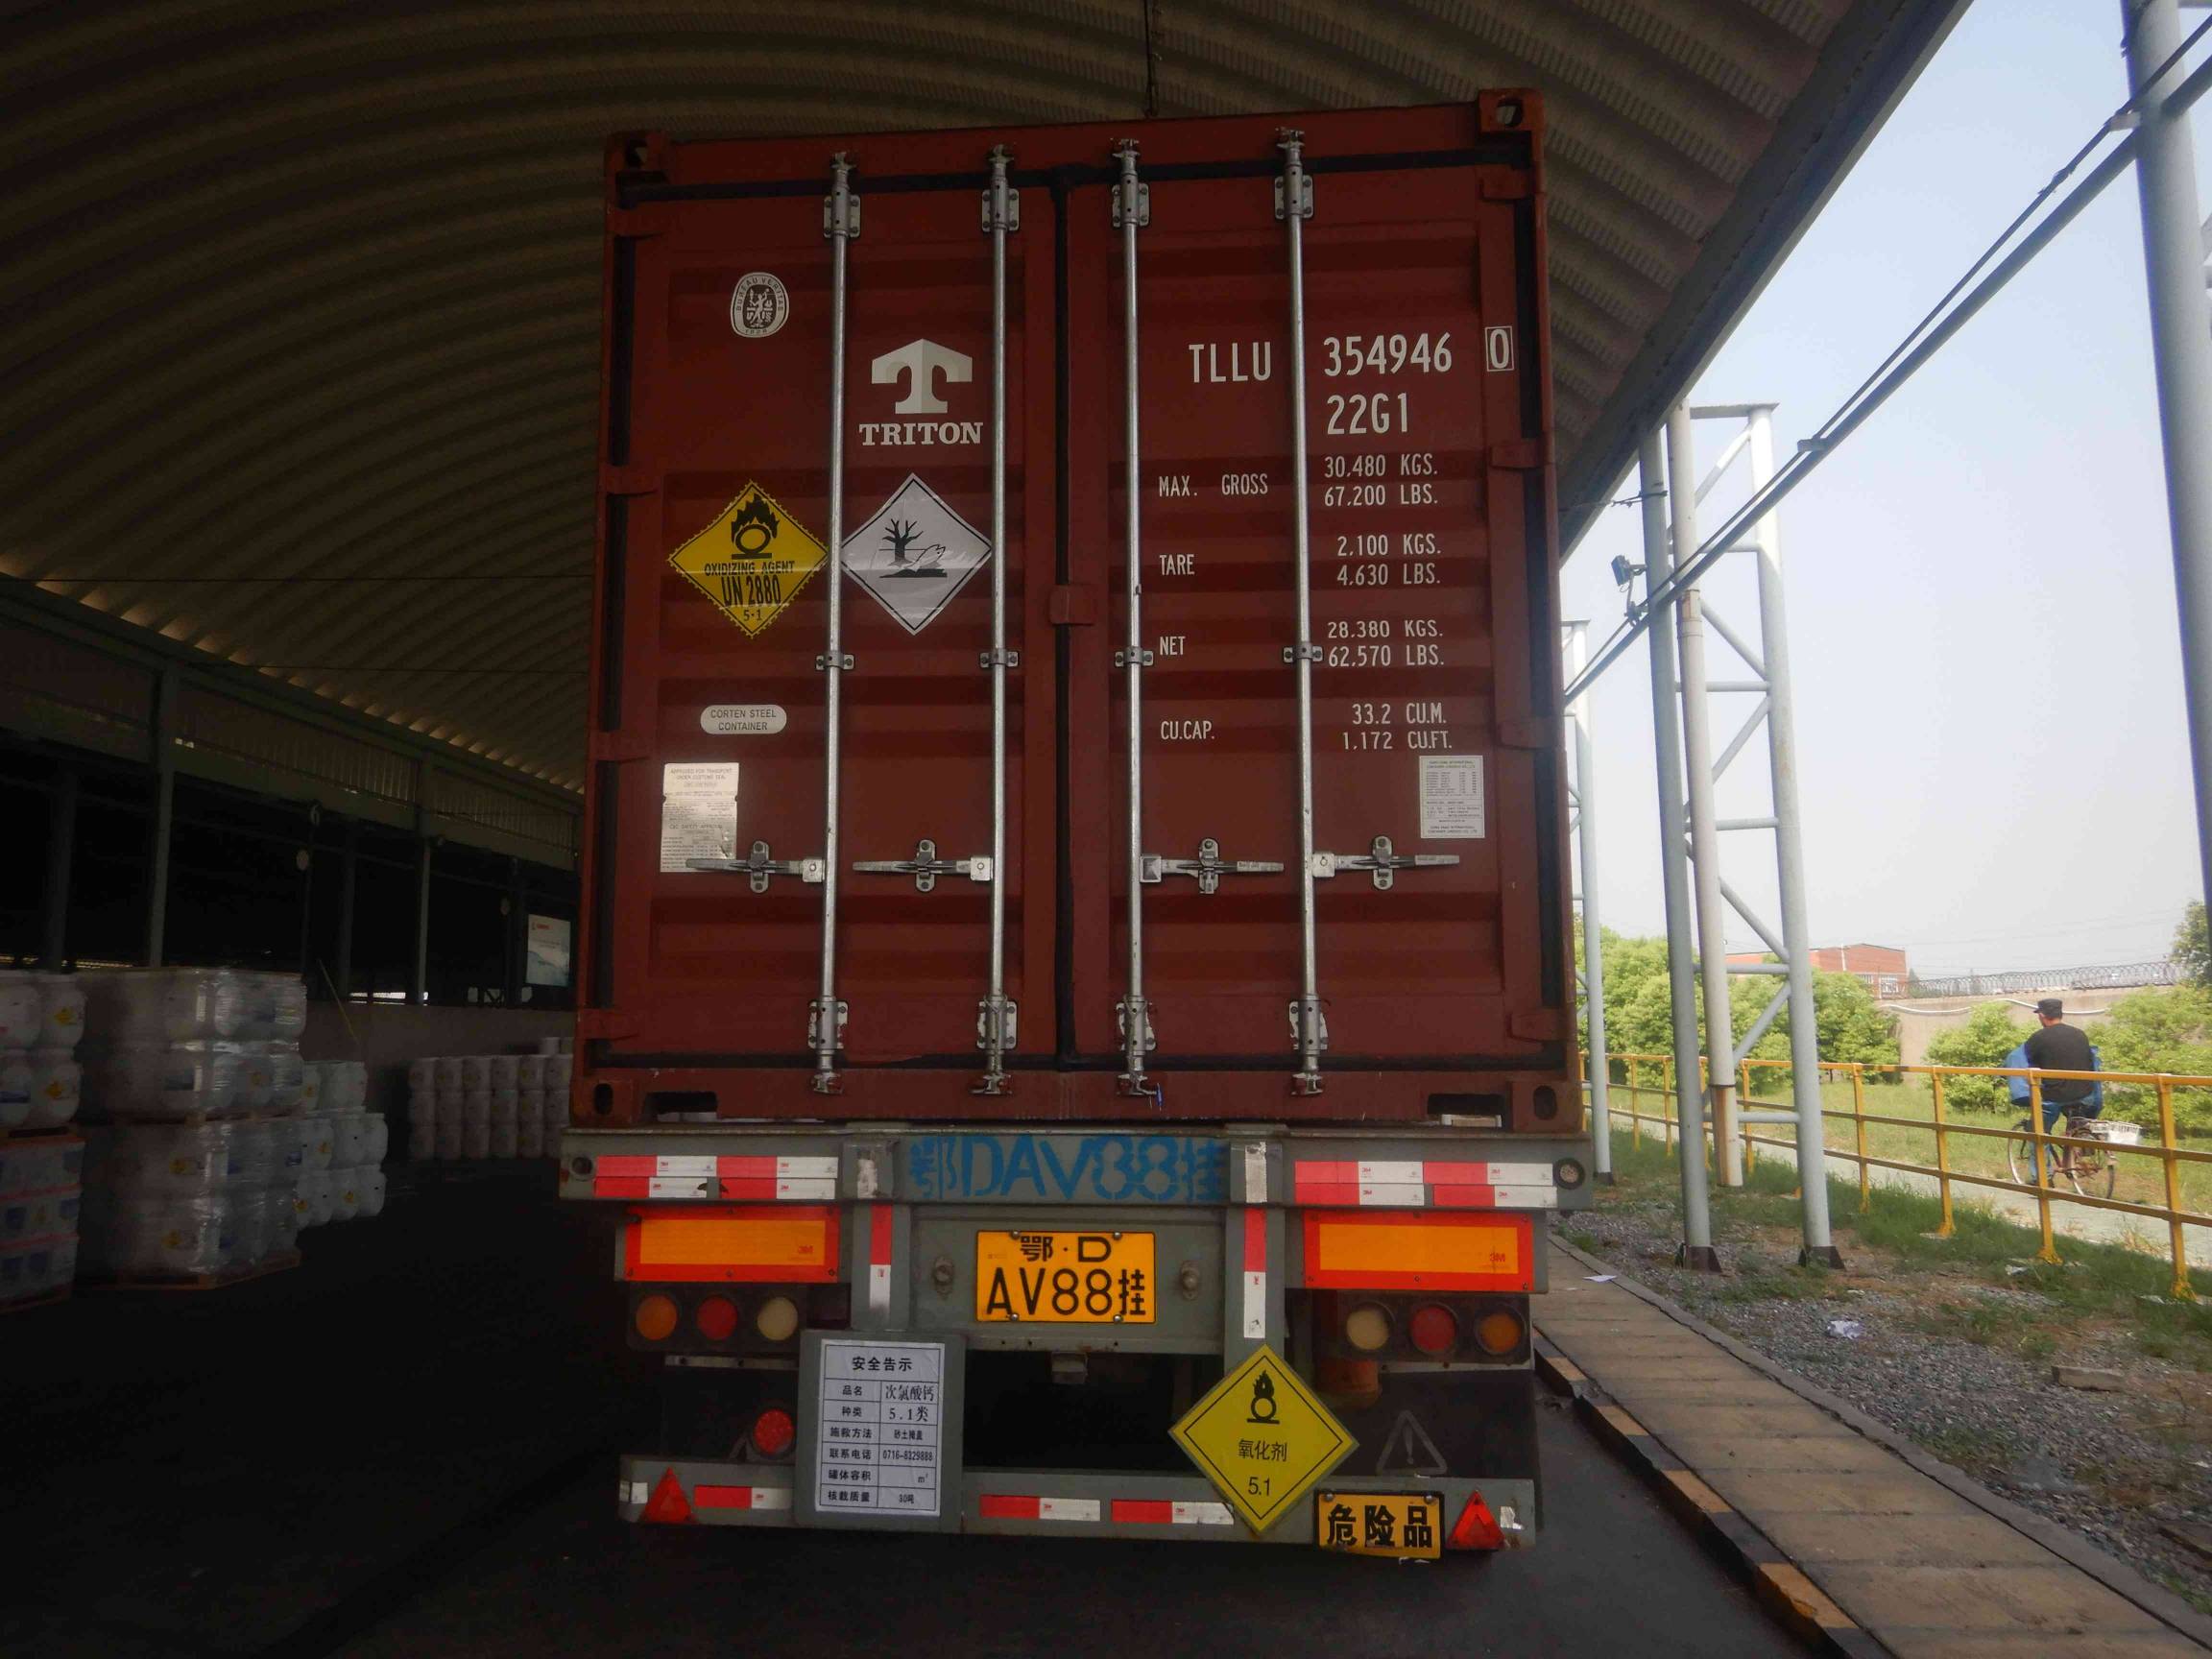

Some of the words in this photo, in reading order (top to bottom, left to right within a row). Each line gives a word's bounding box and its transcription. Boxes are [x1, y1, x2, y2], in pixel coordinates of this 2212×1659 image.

[1189, 341, 1272, 383] TLLU
[1323, 332, 1453, 377] 354946
[1487, 326, 1511, 371] 0
[1327, 392, 1408, 435] 22G1
[858, 421, 984, 445] TRITON
[1401, 453, 1438, 475] KGS.
[1159, 475, 1198, 496] MAX.
[1221, 473, 1268, 495] GROSS
[1401, 483, 1438, 505] LBS.
[1403, 533, 1441, 555] KGS.
[704, 562, 756, 576] OXIDIZING
[761, 560, 795, 574] AGENT
[1159, 554, 1195, 576] TARE
[1403, 563, 1441, 585] LBS.
[721, 575, 743, 607] UN
[745, 574, 781, 606] 2880
[1405, 619, 1443, 637] KGS.
[1159, 637, 1186, 656] NET
[1406, 644, 1444, 665] LBS.
[710, 709, 746, 719] CORTEN
[749, 709, 777, 718] STEEL
[1352, 703, 1391, 725] 33.2
[1406, 702, 1447, 724] CU.M.
[718, 721, 768, 731] CONTAINER
[1161, 720, 1214, 739] CU.CAP.
[985, 1266, 1147, 1315] AV88挂
[852, 1357, 913, 1372] 安全告示
[842, 1385, 863, 1397] 品名
[885, 1384, 935, 1403] 次氯酸钙
[841, 1406, 862, 1418] 种类
[830, 1427, 873, 1439] 施救方法
[829, 1448, 872, 1460] 联系电话
[1238, 1438, 1288, 1462] 氧化剂
[828, 1469, 872, 1481] 罐体容积
[828, 1490, 871, 1503] 核载质量
[1247, 1476, 1272, 1497] 5.1
[1326, 1503, 1432, 1549] 危险品
